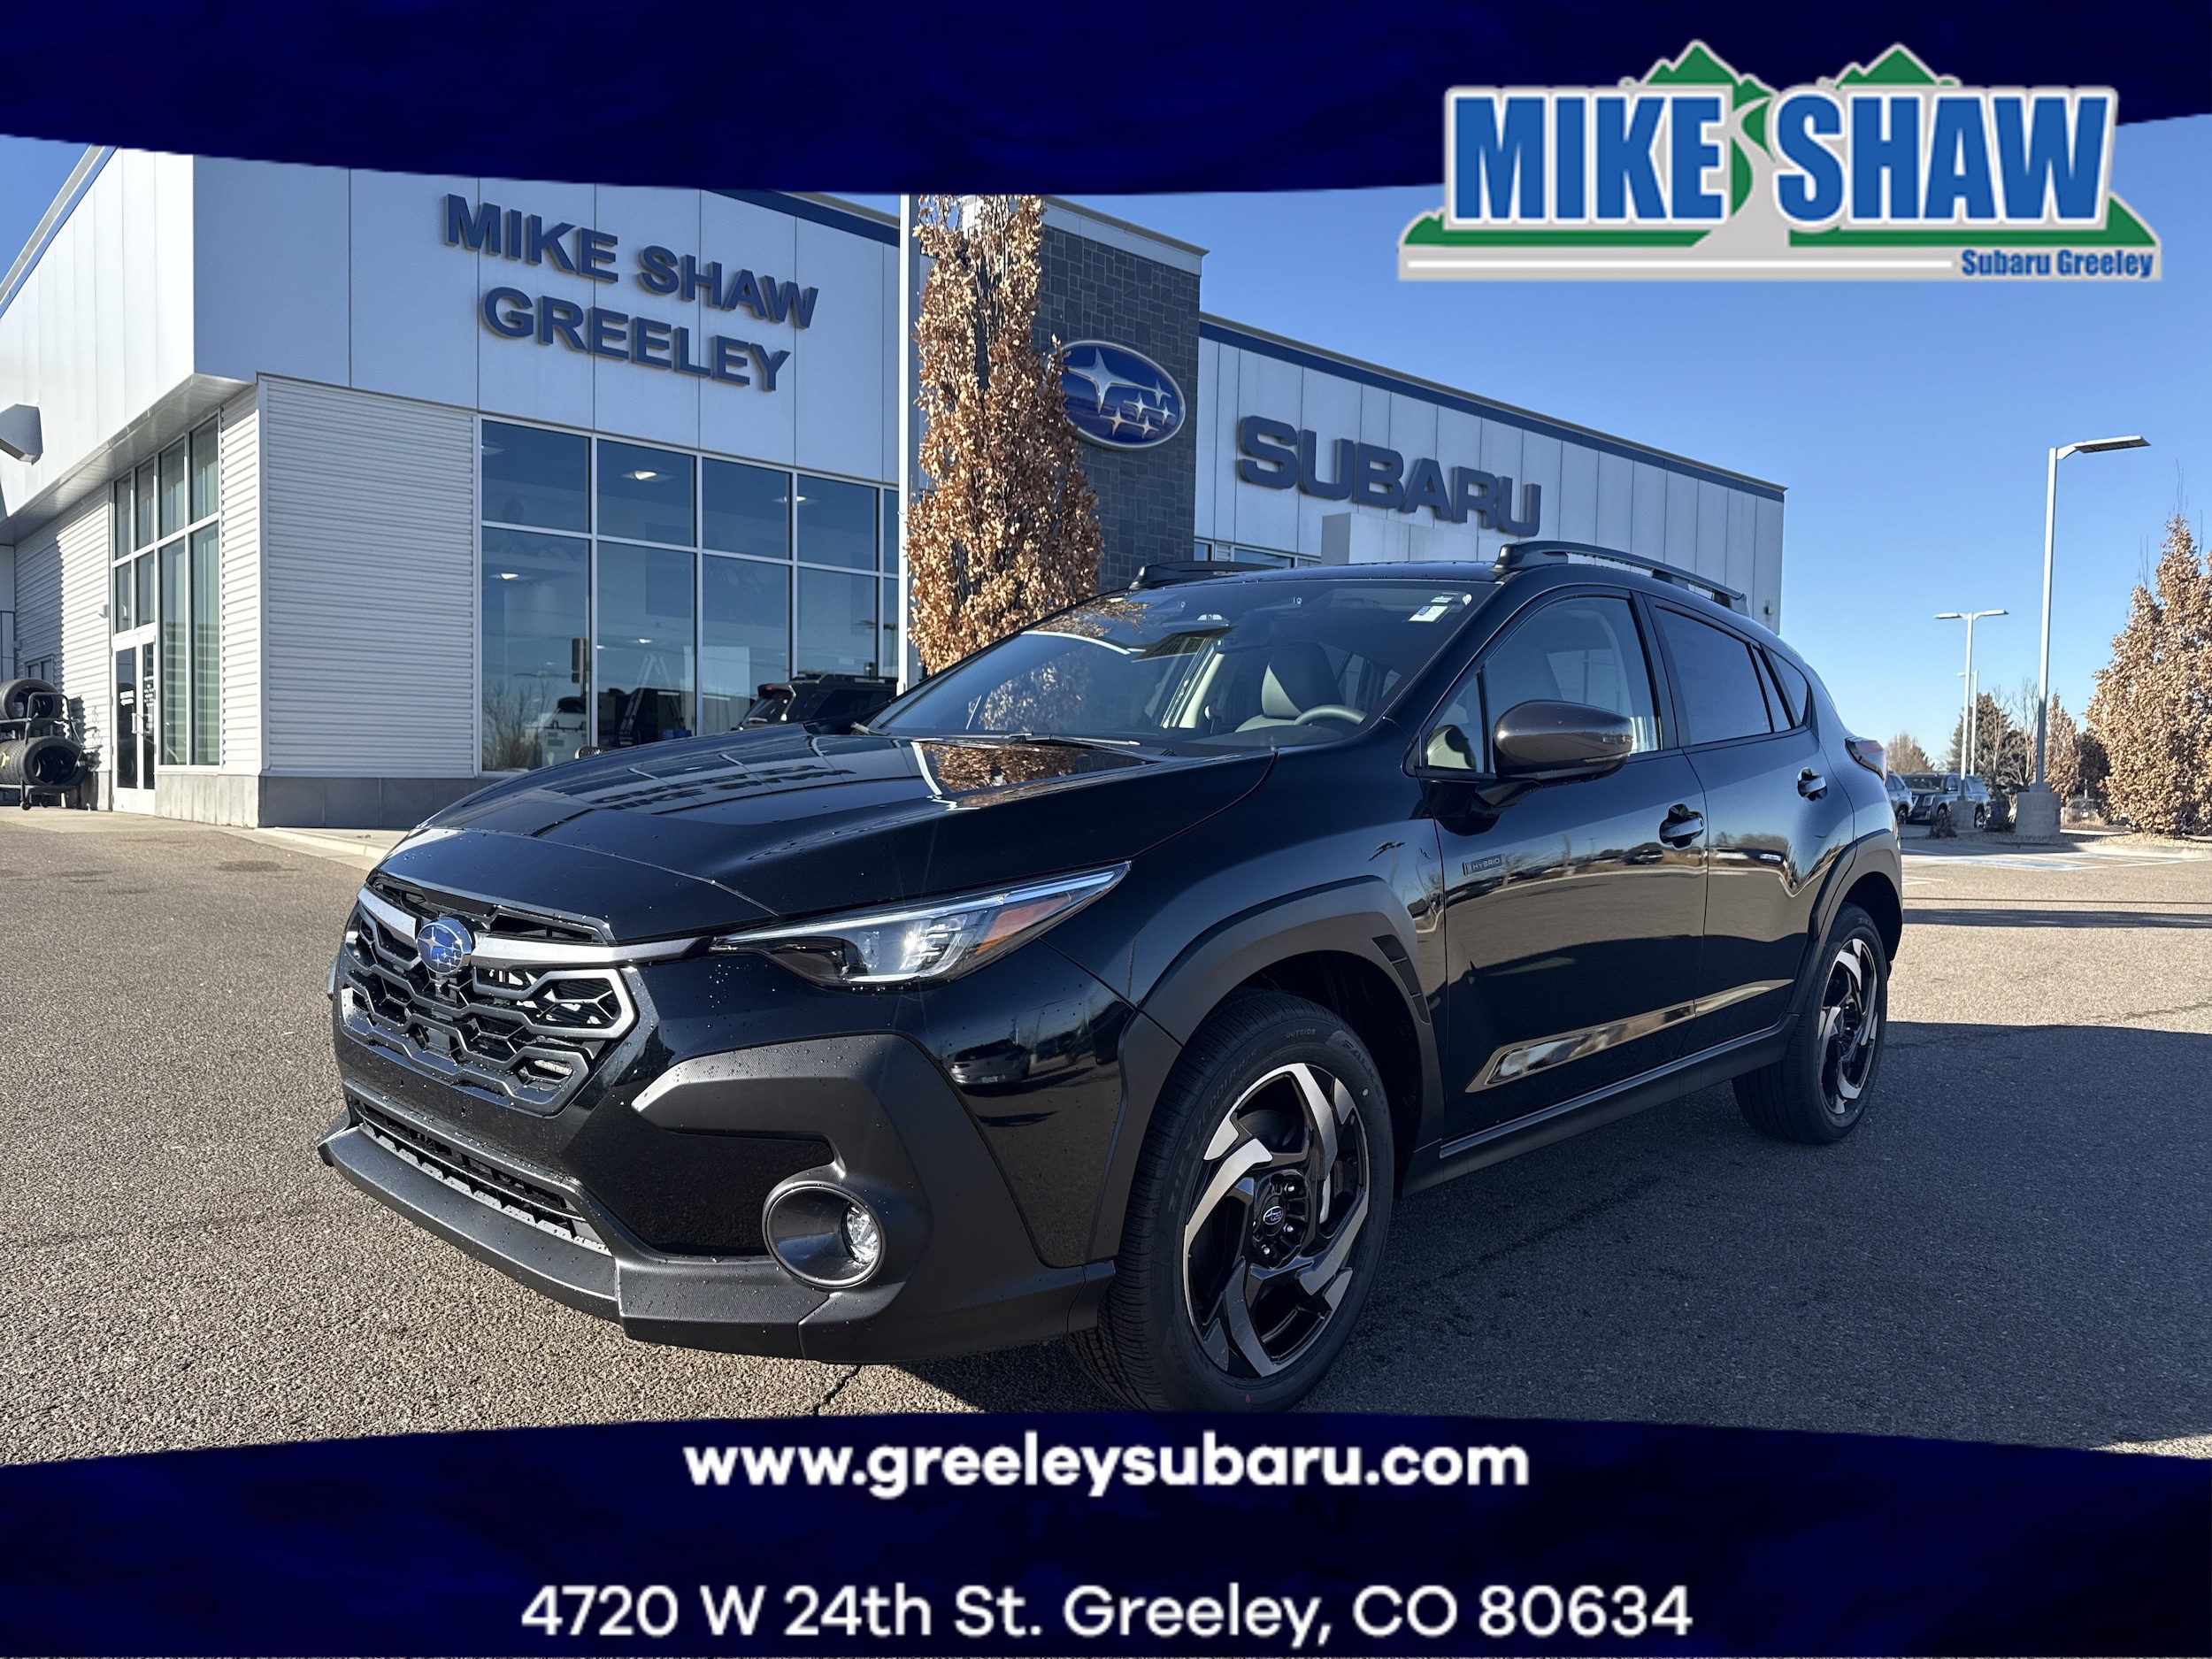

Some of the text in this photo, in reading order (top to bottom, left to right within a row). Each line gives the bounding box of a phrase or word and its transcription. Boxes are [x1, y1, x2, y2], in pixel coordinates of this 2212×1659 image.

[442, 193, 818, 329] MIKE SHAW
[480, 287, 790, 391] GREELEY
[1236, 414, 1541, 537] SUBARU
[1471, 857, 1501, 871] HYBRID
[1286, 1028, 1316, 1039] OUTSIDE
